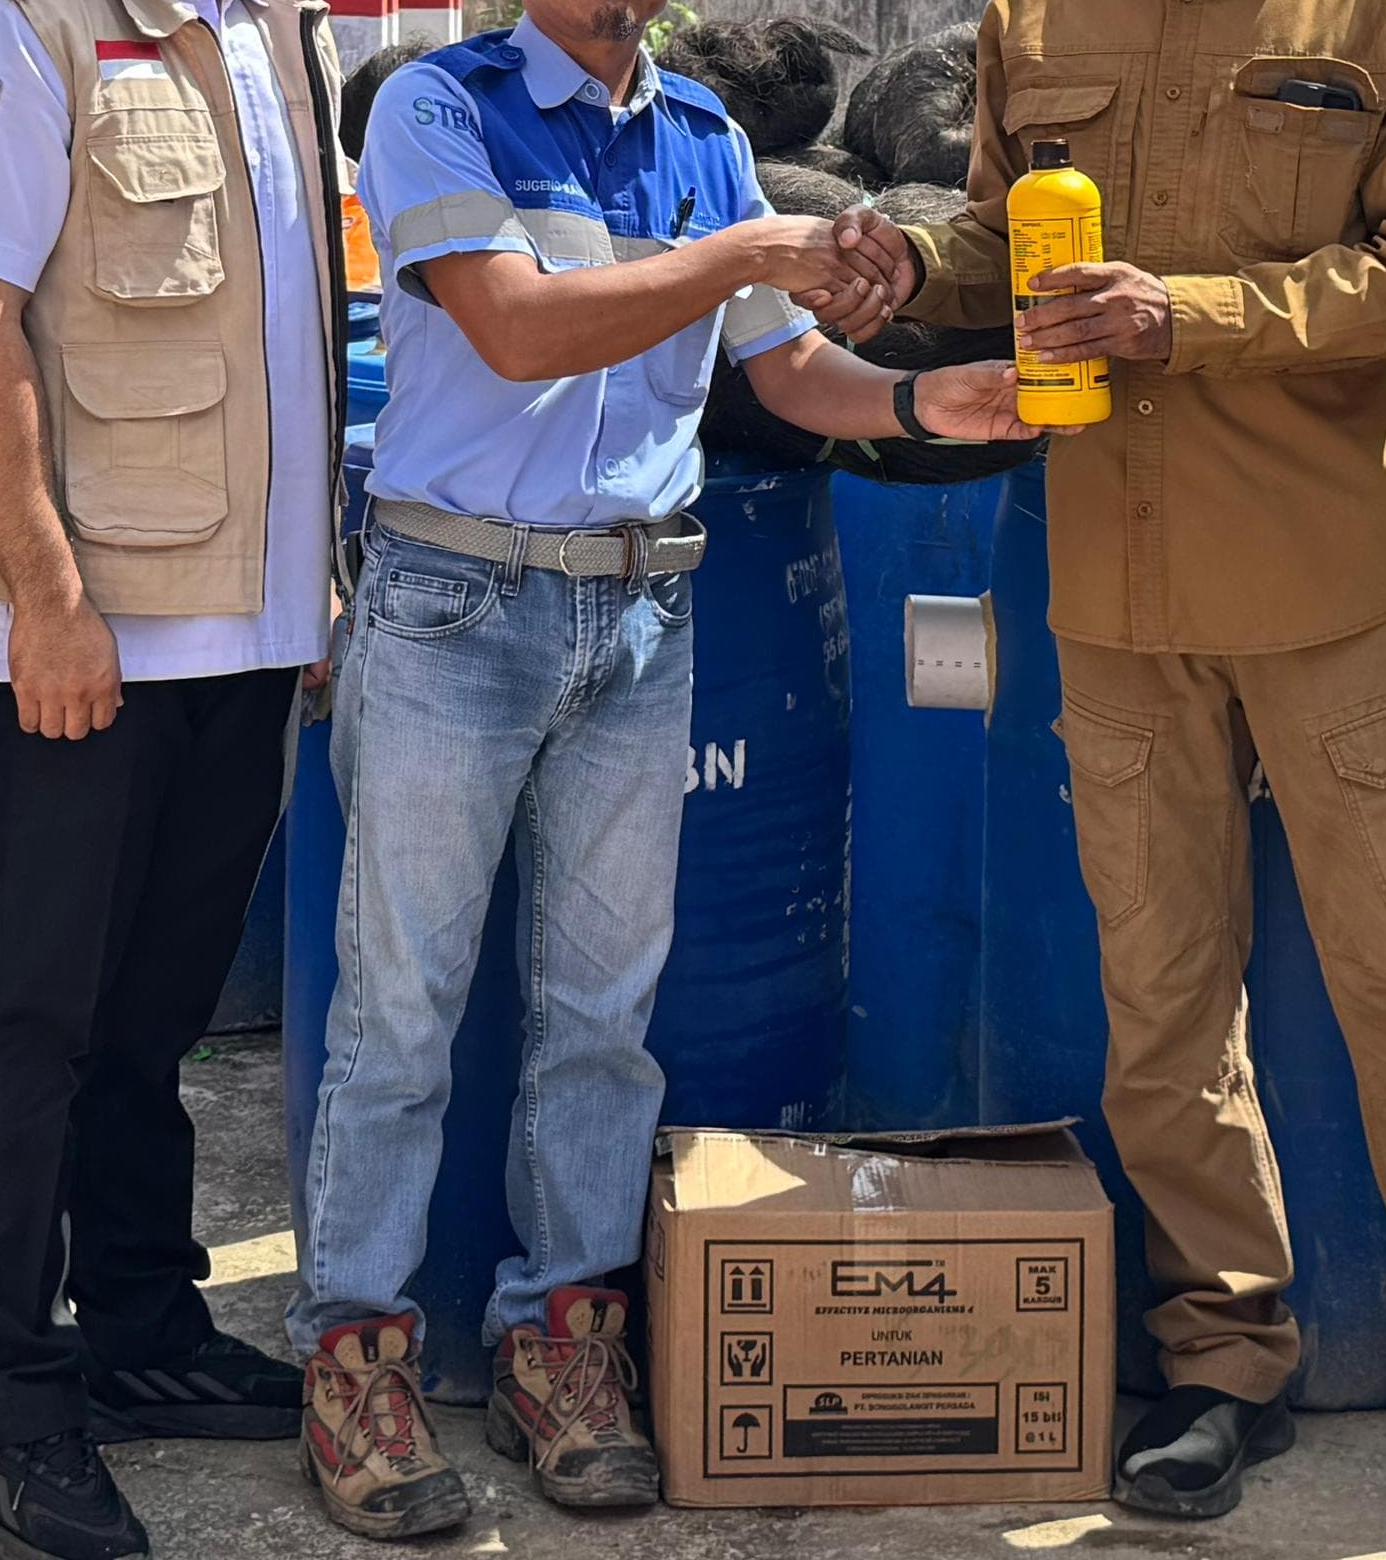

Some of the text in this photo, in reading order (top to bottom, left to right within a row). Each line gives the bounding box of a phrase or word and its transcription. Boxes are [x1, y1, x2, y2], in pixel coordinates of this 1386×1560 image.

[831, 1260, 958, 1304] EM4
[1035, 1276, 1051, 1295] 5
[814, 1306, 870, 1315] EFFECTIVE
[871, 1330, 913, 1342] UNTUK
[840, 1351, 944, 1366] PERTANIAN
[818, 1394, 841, 1407] SLP
[1023, 1411, 1039, 1423] 15
